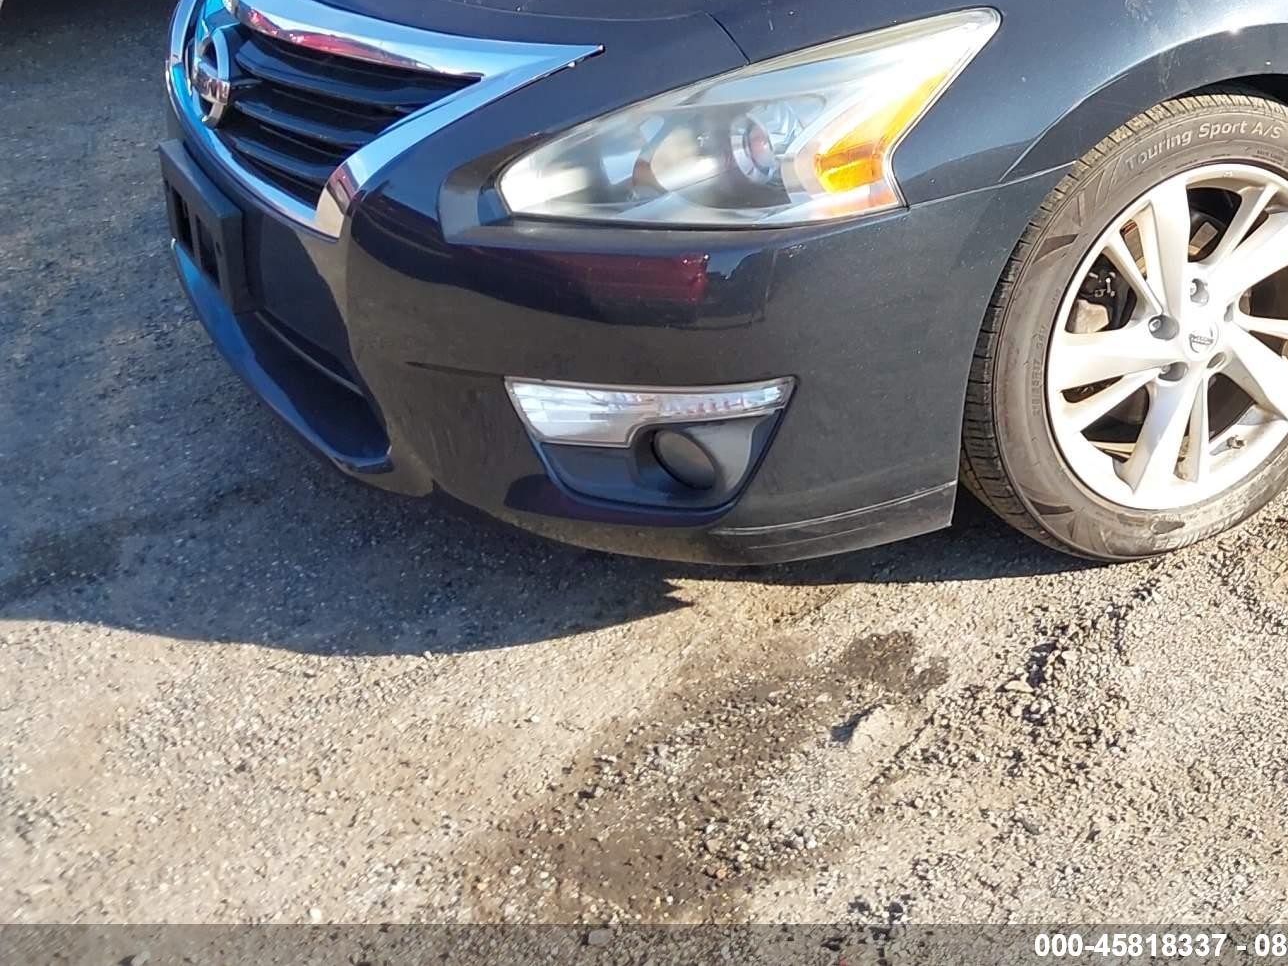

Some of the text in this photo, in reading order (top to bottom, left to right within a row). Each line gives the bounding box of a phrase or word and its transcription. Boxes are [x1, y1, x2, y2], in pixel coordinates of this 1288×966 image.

[1124, 120, 1284, 170] Touring Sport A/S
